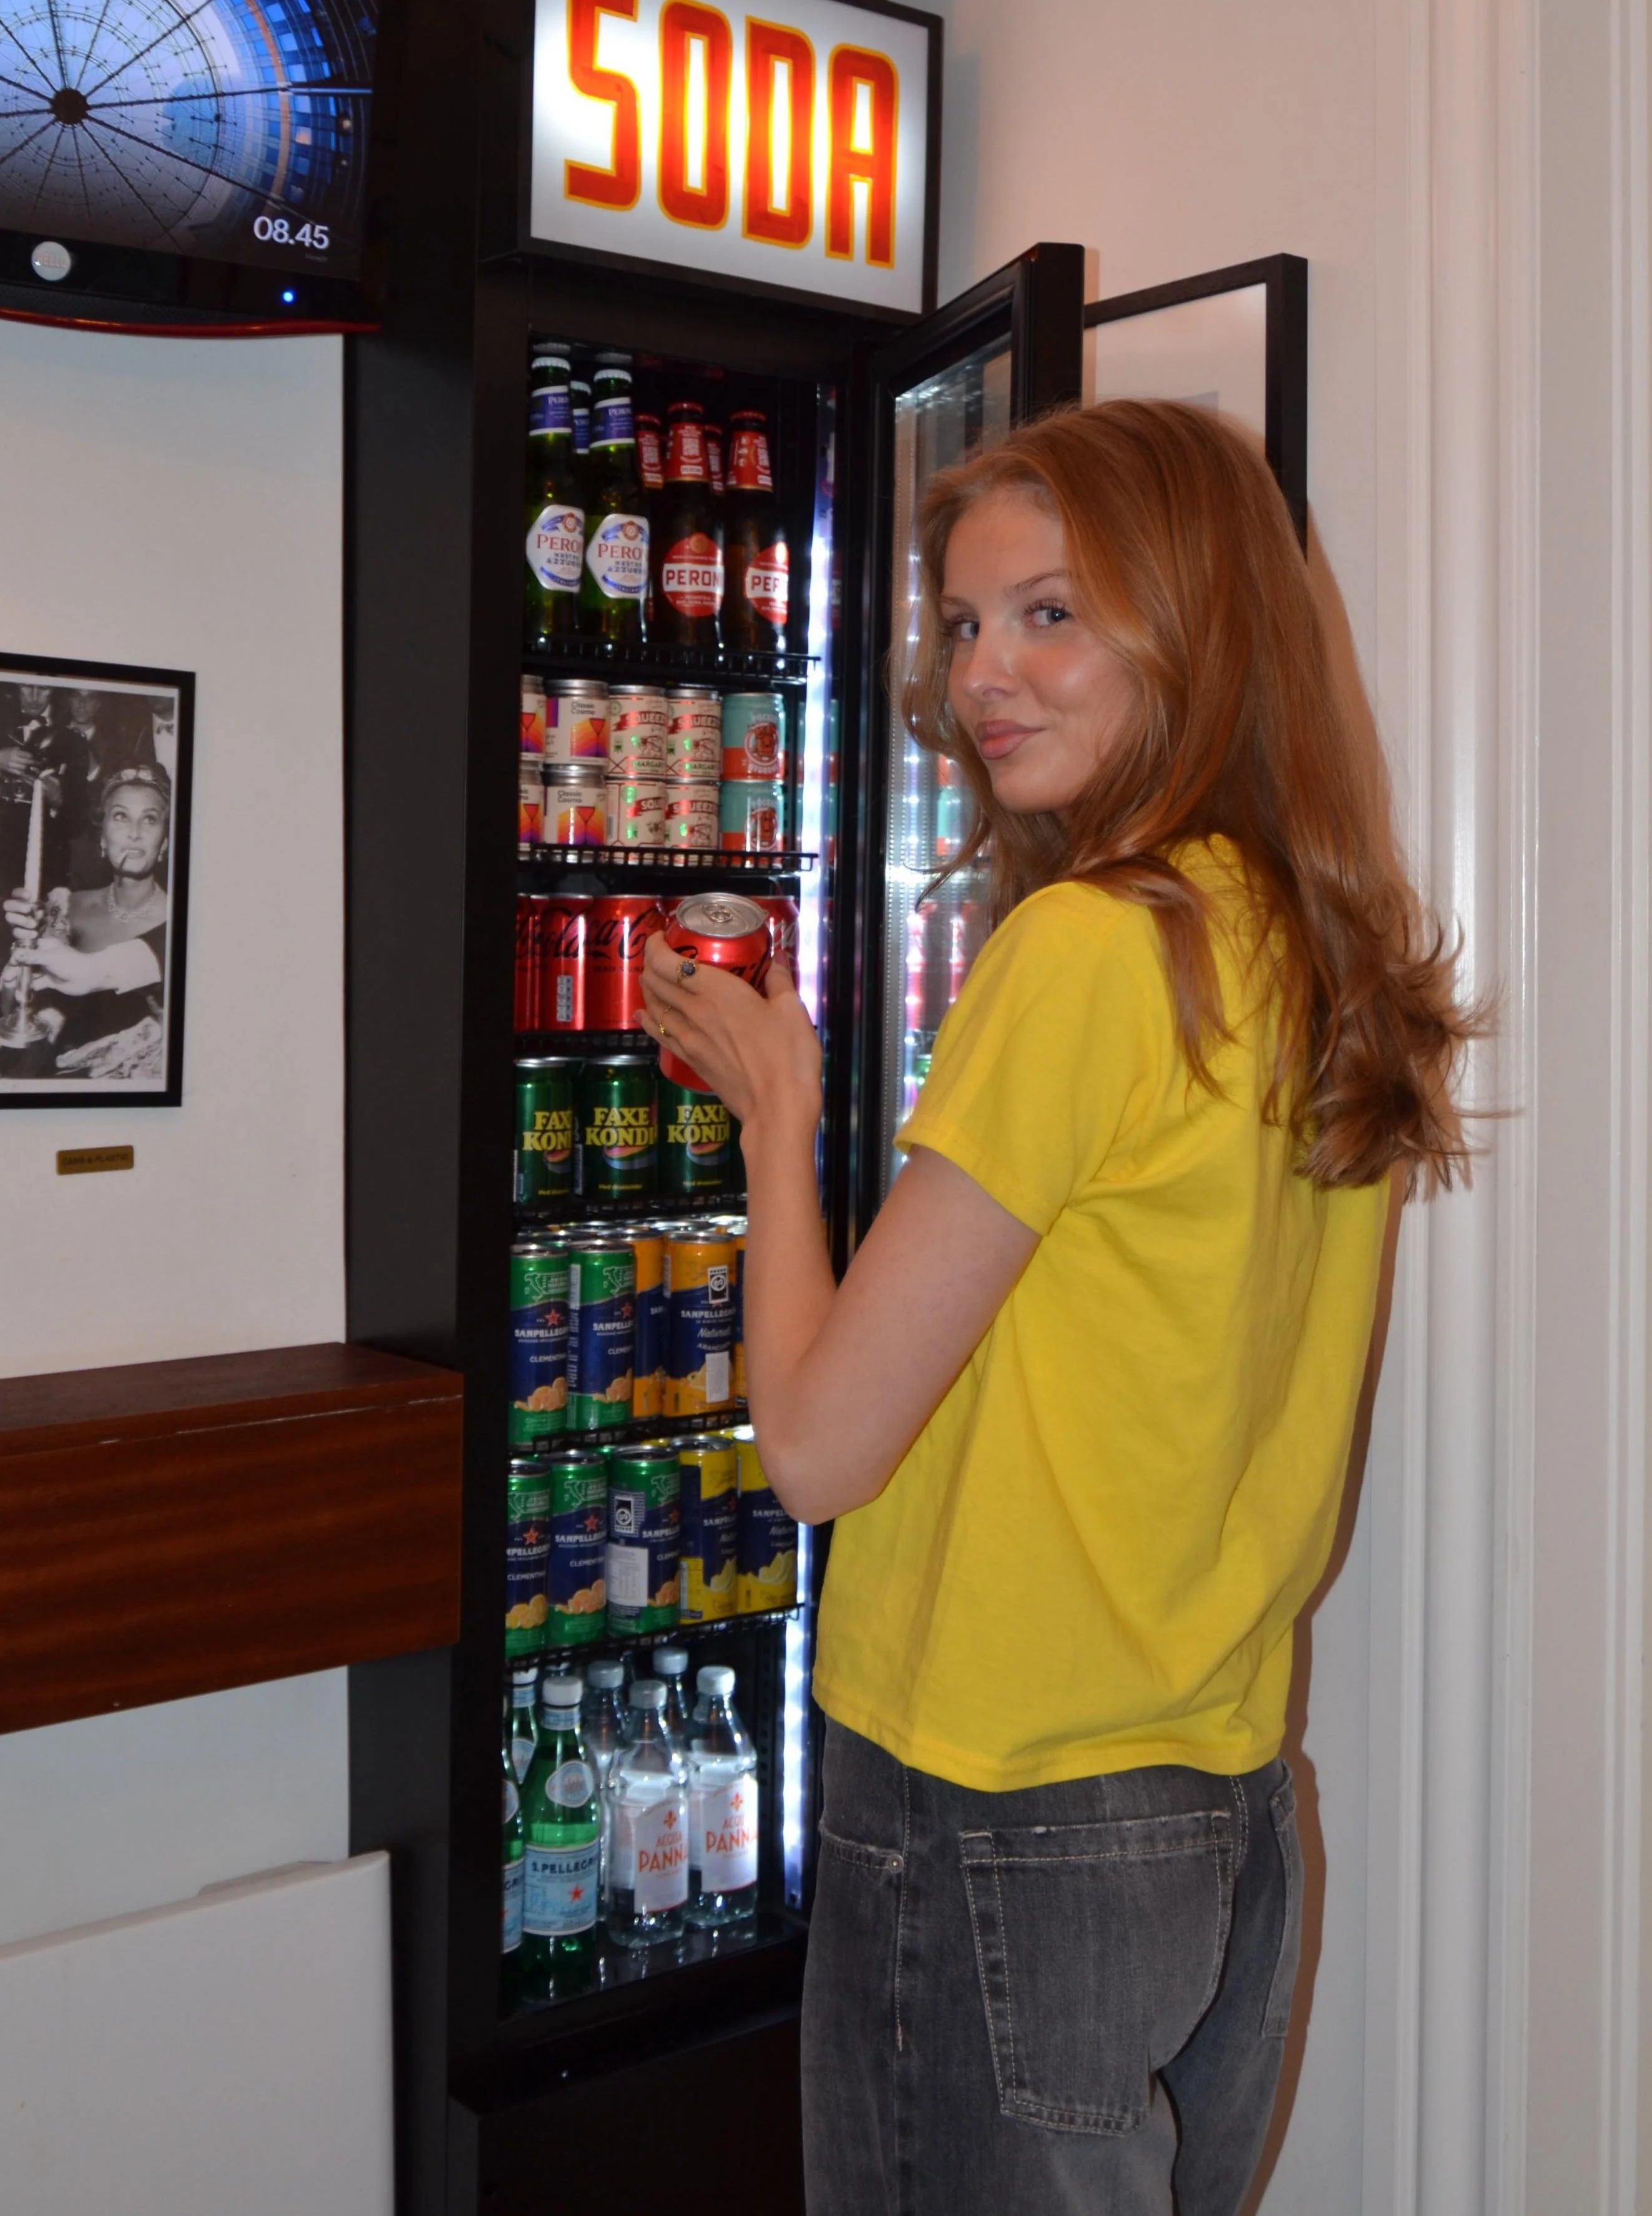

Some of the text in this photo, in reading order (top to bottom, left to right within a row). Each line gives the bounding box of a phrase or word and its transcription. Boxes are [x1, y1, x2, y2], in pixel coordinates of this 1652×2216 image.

[563, 0, 899, 269] SODA
[253, 216, 330, 250] 08.45
[594, 1106, 650, 1127] FAXE
[585, 1126, 655, 1147] KONDI
